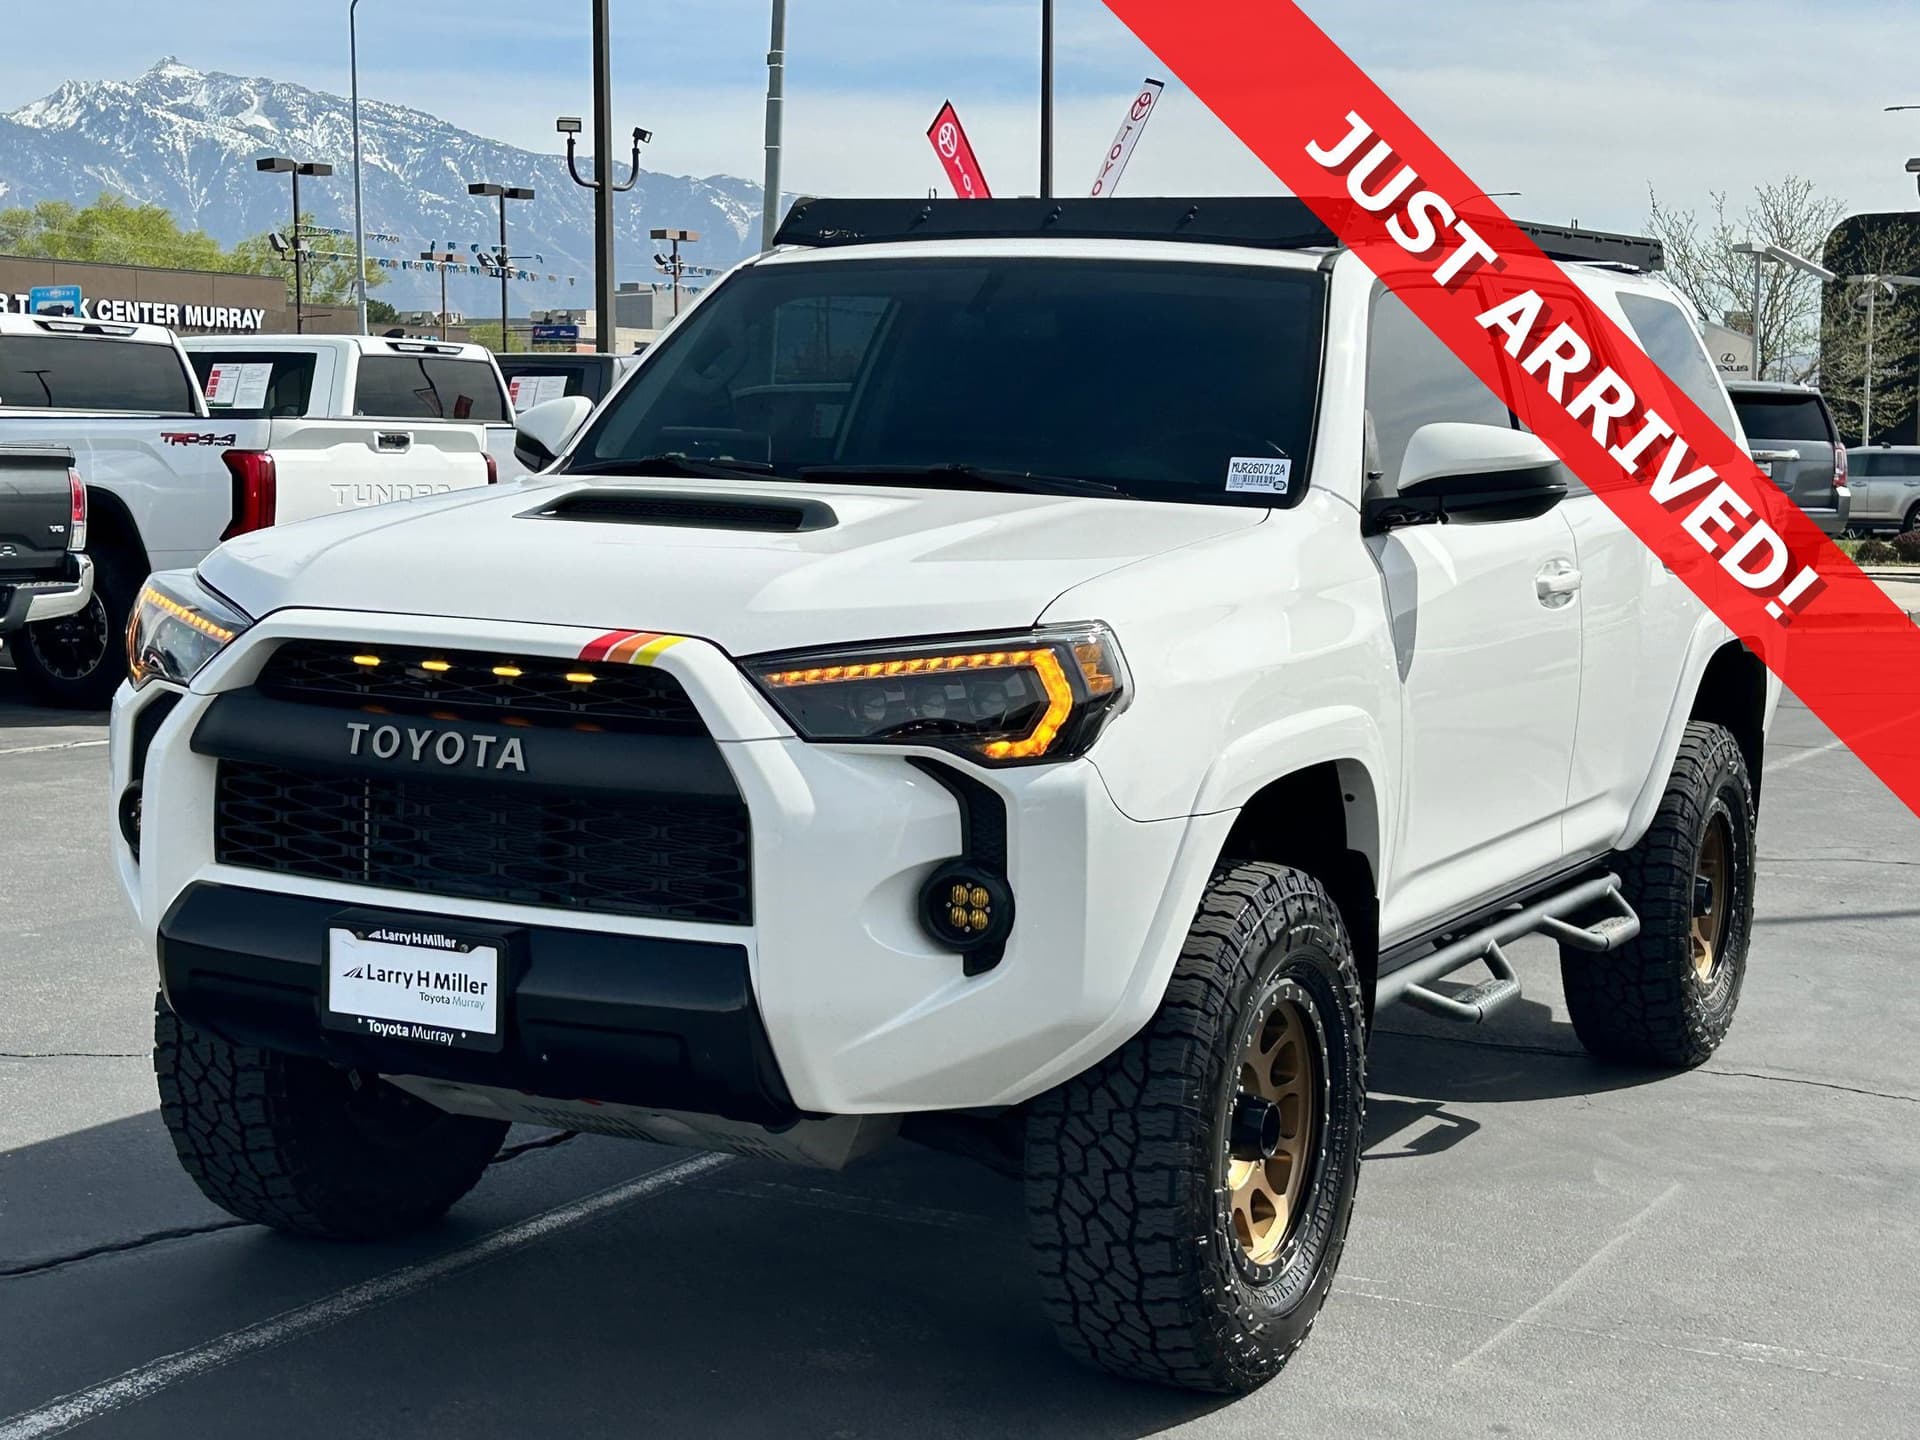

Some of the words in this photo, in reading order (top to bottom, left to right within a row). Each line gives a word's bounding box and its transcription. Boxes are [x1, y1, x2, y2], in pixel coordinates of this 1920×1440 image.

[96, 299, 179, 325] CENTER
[185, 305, 265, 329] MURRAY
[1231, 462, 1286, 476] MUR260712A
[347, 722, 526, 772] TOYOTA
[381, 928, 411, 946] Larry
[412, 932, 422, 945] H
[423, 933, 457, 949] Miller
[367, 963, 413, 989] Larry
[417, 970, 430, 988] H
[434, 972, 488, 995] Miller
[419, 991, 450, 1005] Toyota
[452, 995, 485, 1010] Murray
[367, 1019, 409, 1037] Toyota
[411, 1025, 454, 1046] Murray
